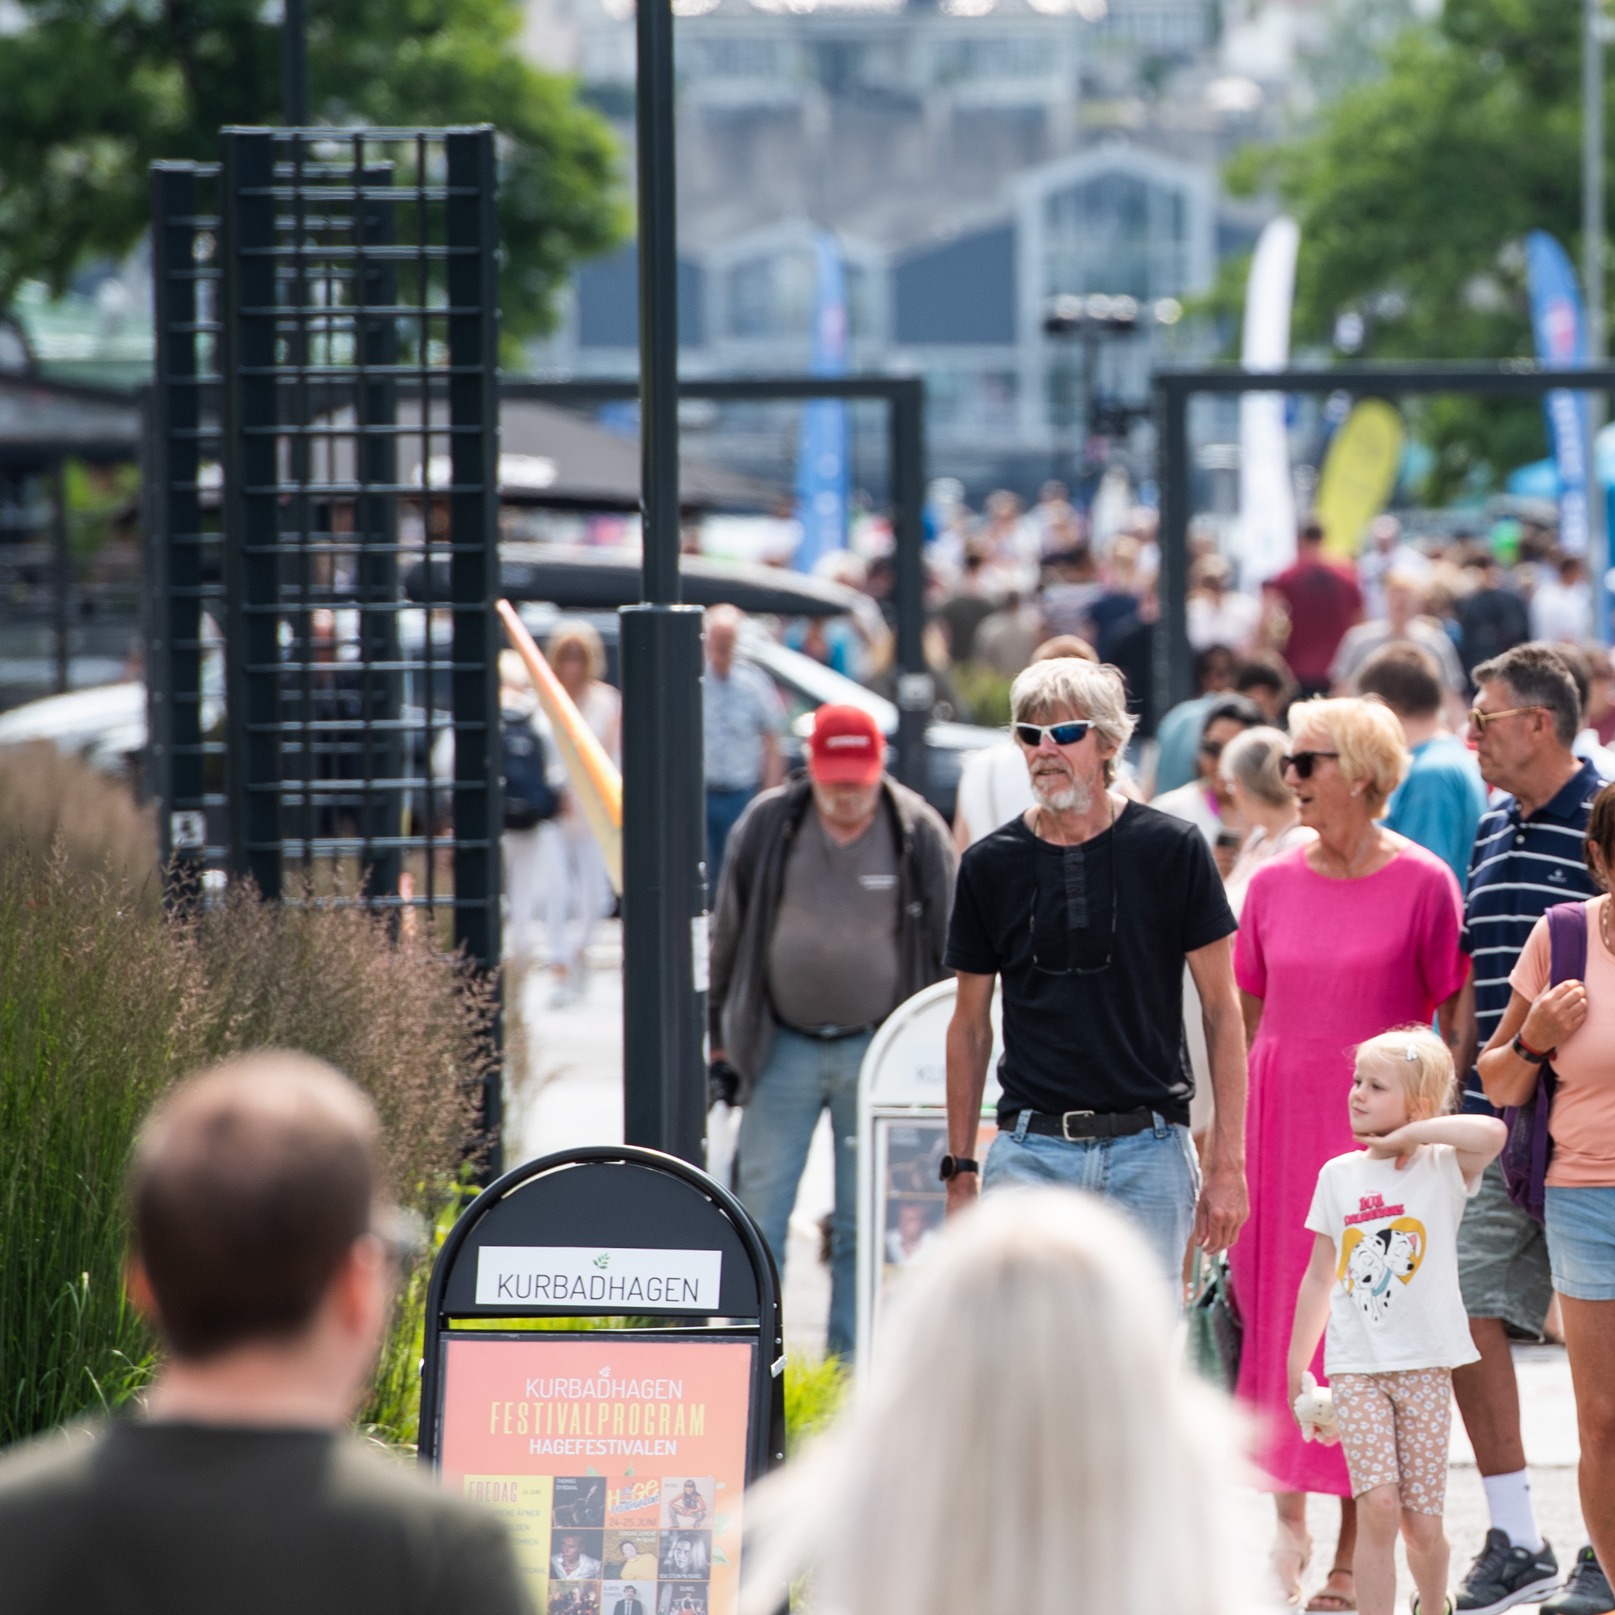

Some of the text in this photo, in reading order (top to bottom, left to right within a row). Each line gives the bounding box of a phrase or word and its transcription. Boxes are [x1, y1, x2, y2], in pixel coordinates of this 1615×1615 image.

[498, 1274, 699, 1302] KURBADHAGEN
[526, 1378, 683, 1399] KURBADHAGEN
[490, 1401, 706, 1436] FESTIVALPROGRAM
[529, 1438, 678, 1456] HAGEFESTIVALEN
[468, 1481, 517, 1502] FREDAG
[637, 1517, 657, 1527] JUNI
